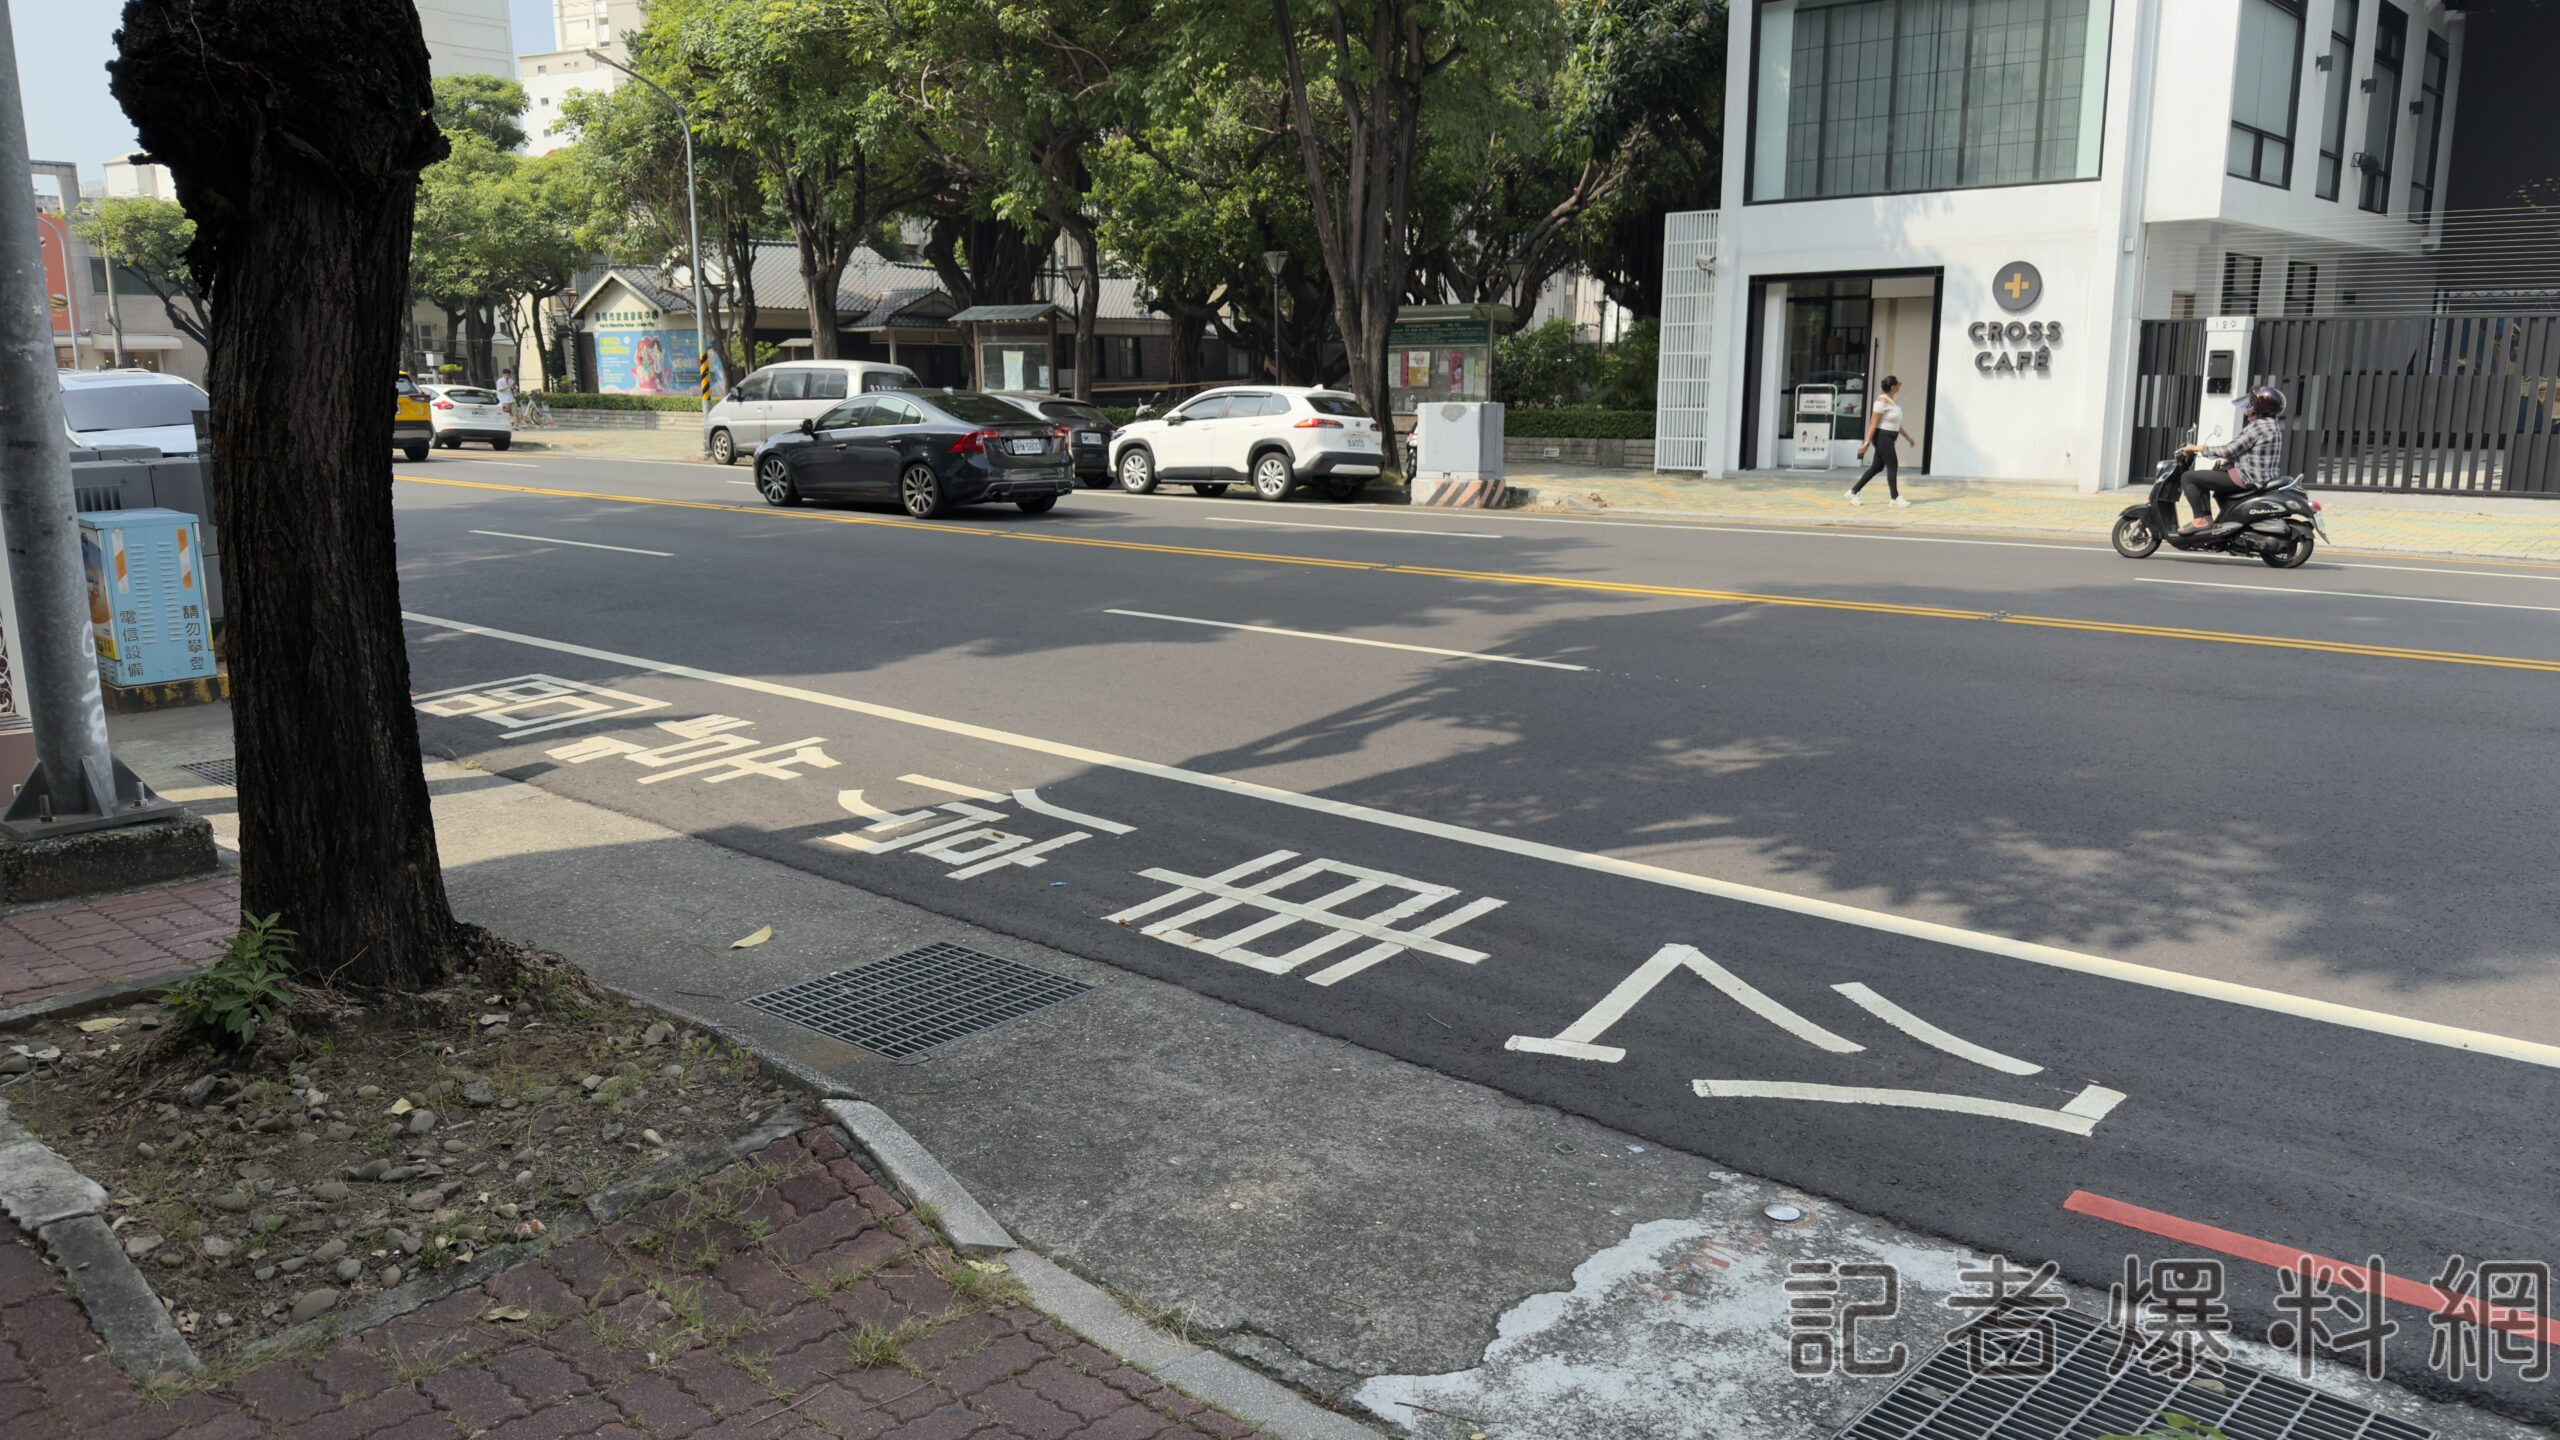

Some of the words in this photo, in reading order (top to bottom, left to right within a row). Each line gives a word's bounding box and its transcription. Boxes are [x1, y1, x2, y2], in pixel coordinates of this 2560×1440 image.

[1968, 321, 2062, 341] CROSS
[2216, 320, 2237, 329] 129
[1975, 345, 2050, 371] CAFÉ
[119, 610, 144, 677] 電信設備
[183, 605, 205, 671] 請勿攀登
